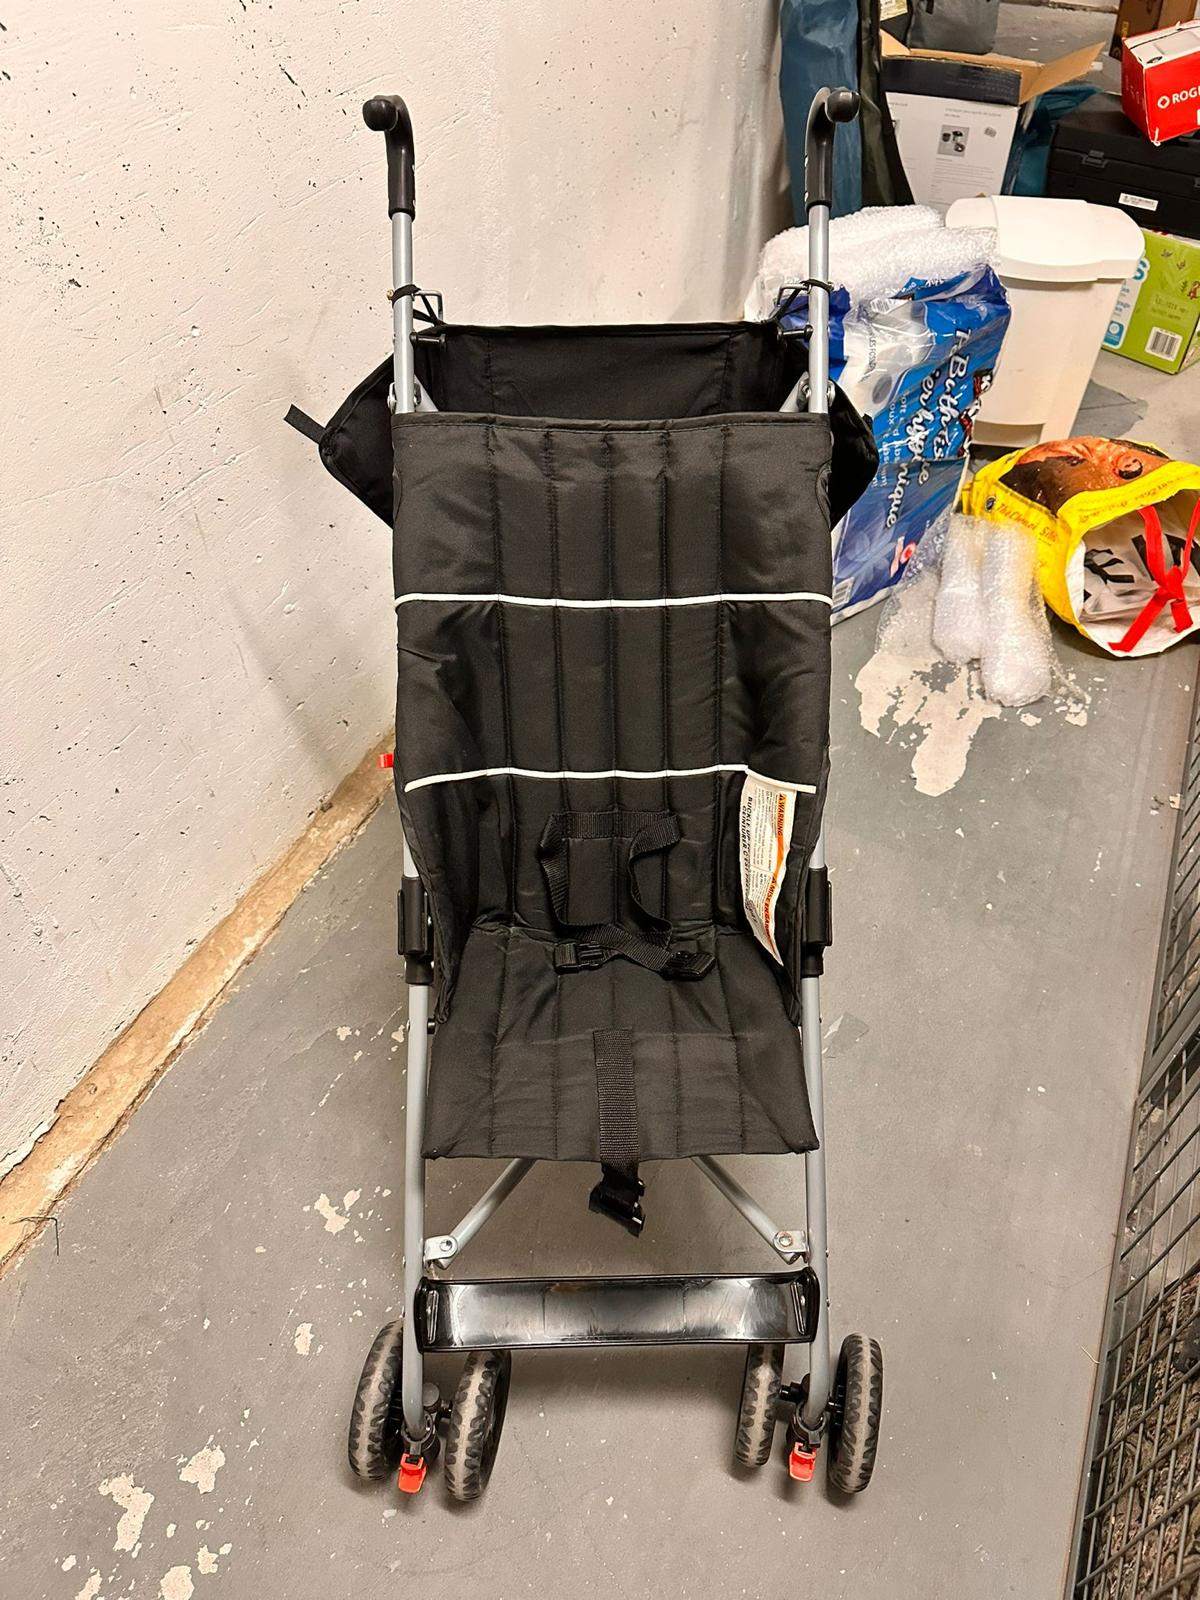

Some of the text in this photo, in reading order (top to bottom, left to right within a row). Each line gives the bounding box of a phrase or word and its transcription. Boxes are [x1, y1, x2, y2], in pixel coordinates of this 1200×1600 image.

[745, 796, 753, 827] BUCKLE
[777, 801, 785, 836] WARNING
[766, 882, 776, 902] MISE
